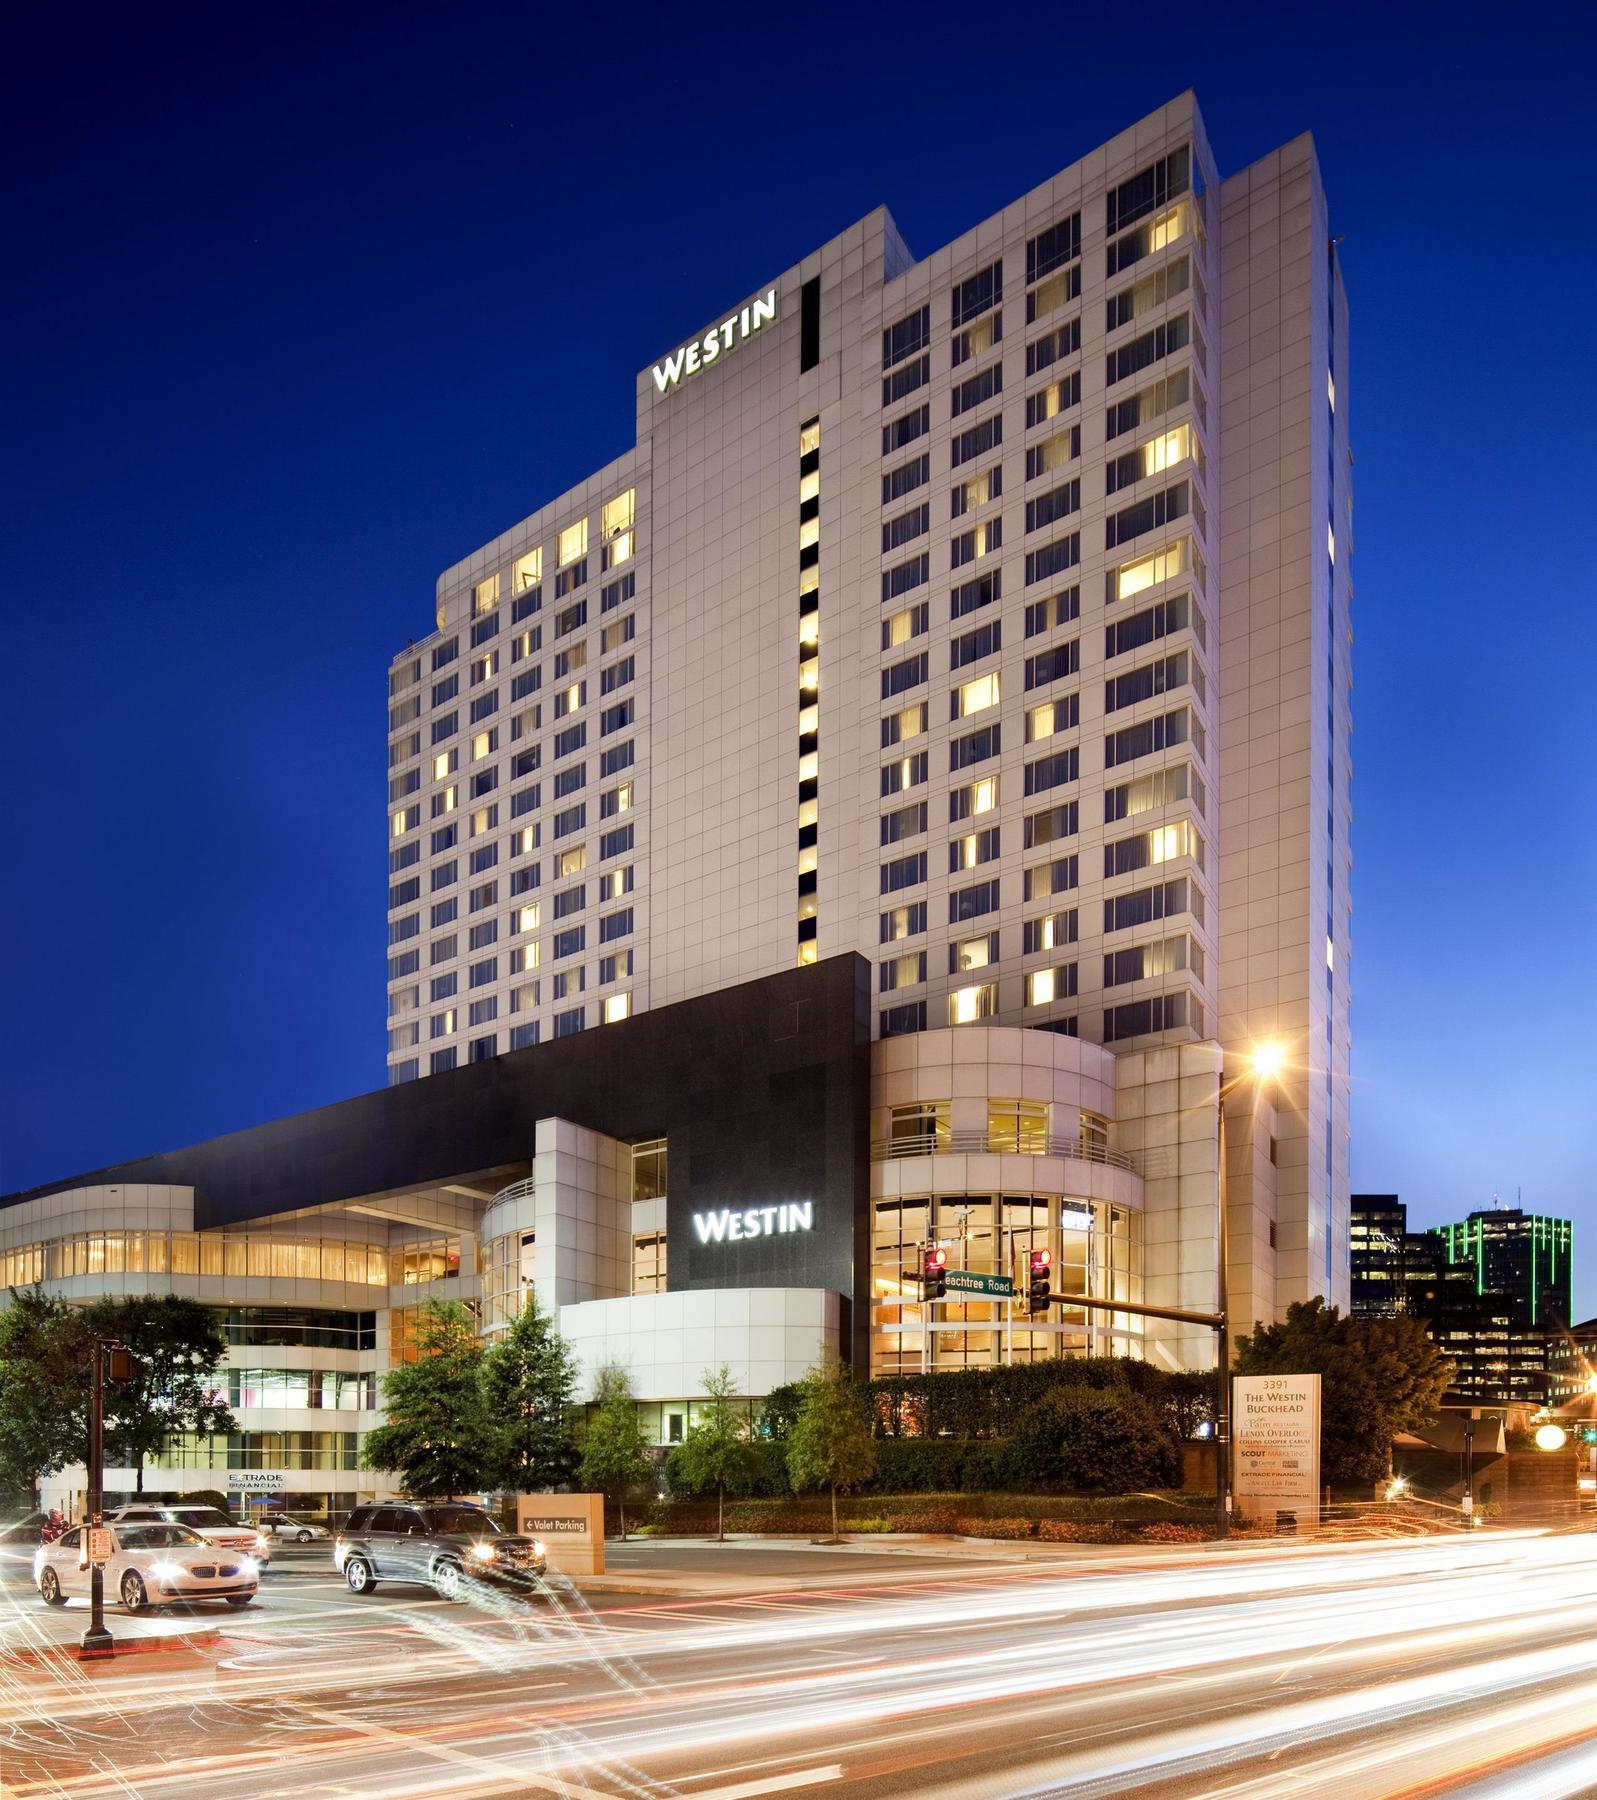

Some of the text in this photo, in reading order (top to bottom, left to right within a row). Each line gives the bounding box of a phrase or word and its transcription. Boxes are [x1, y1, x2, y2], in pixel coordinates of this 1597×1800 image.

[652, 289, 777, 392] WESTIN
[693, 1202, 813, 1244] WESTIN
[945, 1275, 1010, 1292] eachtree Road
[1263, 1380, 1288, 1390] 3391
[1247, 1404, 1304, 1414] BUCKHEAD
[534, 1519, 585, 1532] Valet Parking
